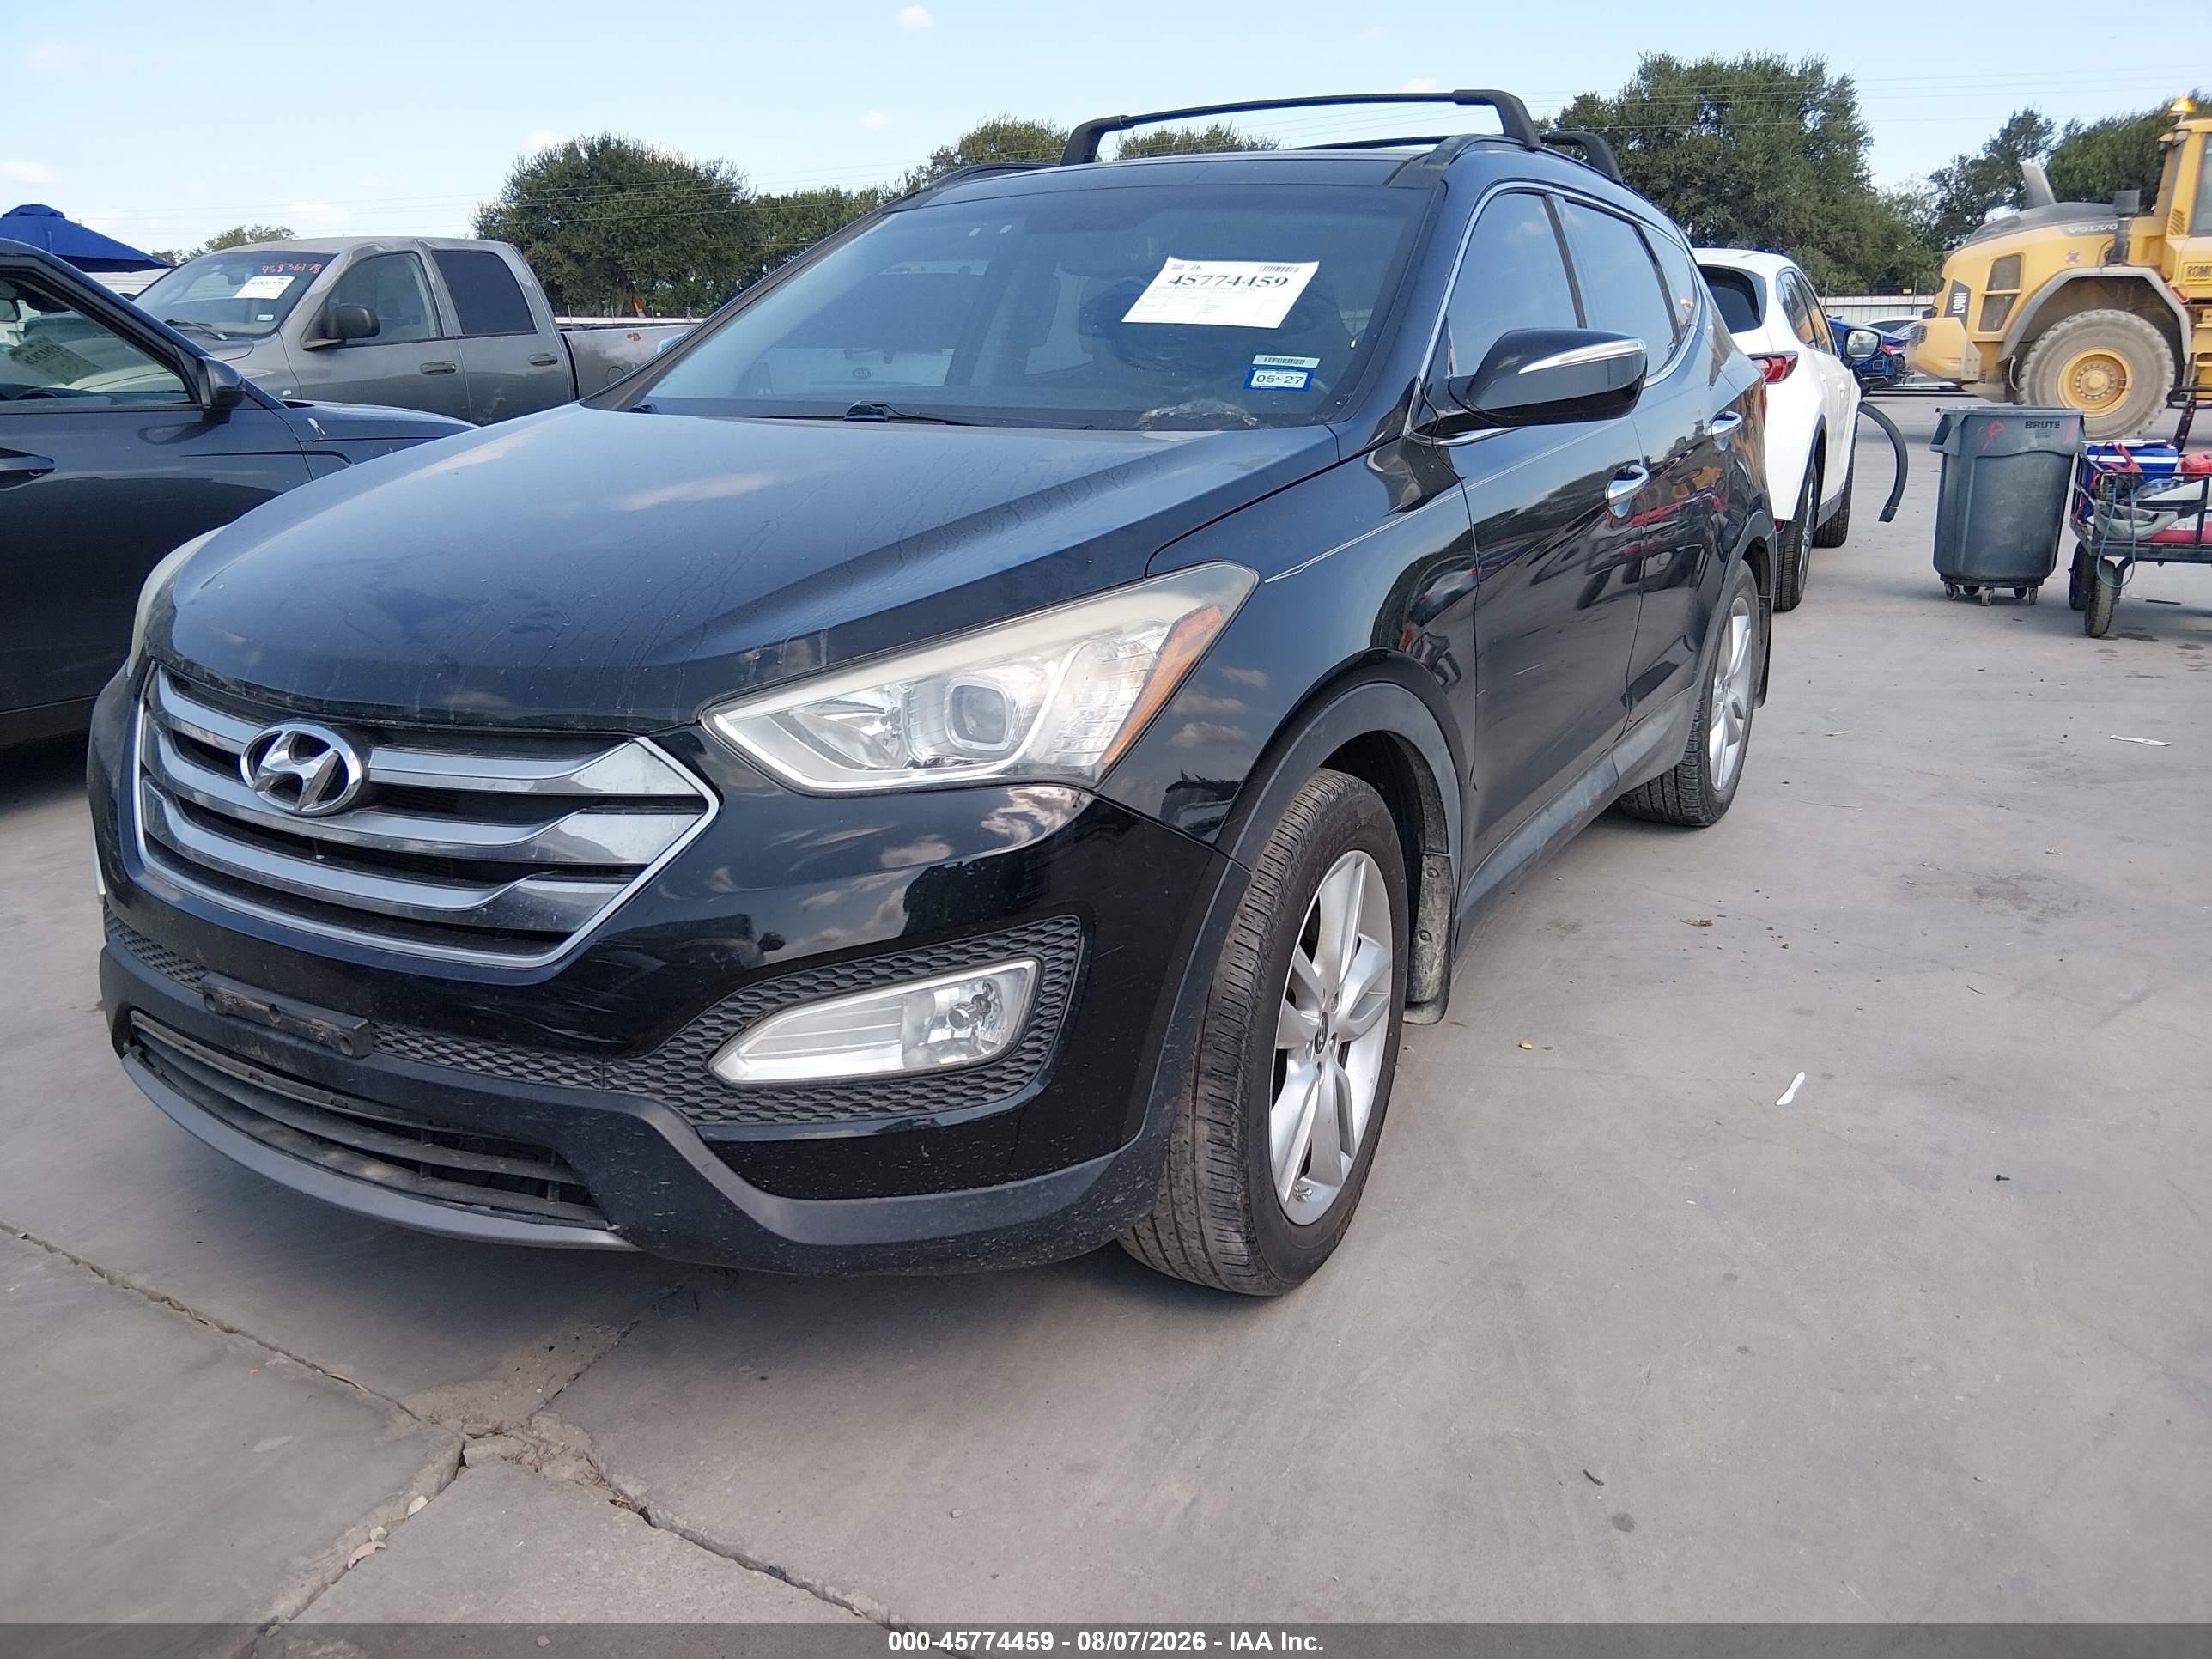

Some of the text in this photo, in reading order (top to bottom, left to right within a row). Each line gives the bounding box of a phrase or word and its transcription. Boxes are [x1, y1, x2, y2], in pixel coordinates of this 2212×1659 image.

[2068, 223, 2118, 233] VOLVO
[1169, 274, 1289, 289] 45774459
[1952, 292, 1967, 314] L90H
[1256, 374, 1275, 383] 05
[2025, 421, 2061, 429] BRUTE
